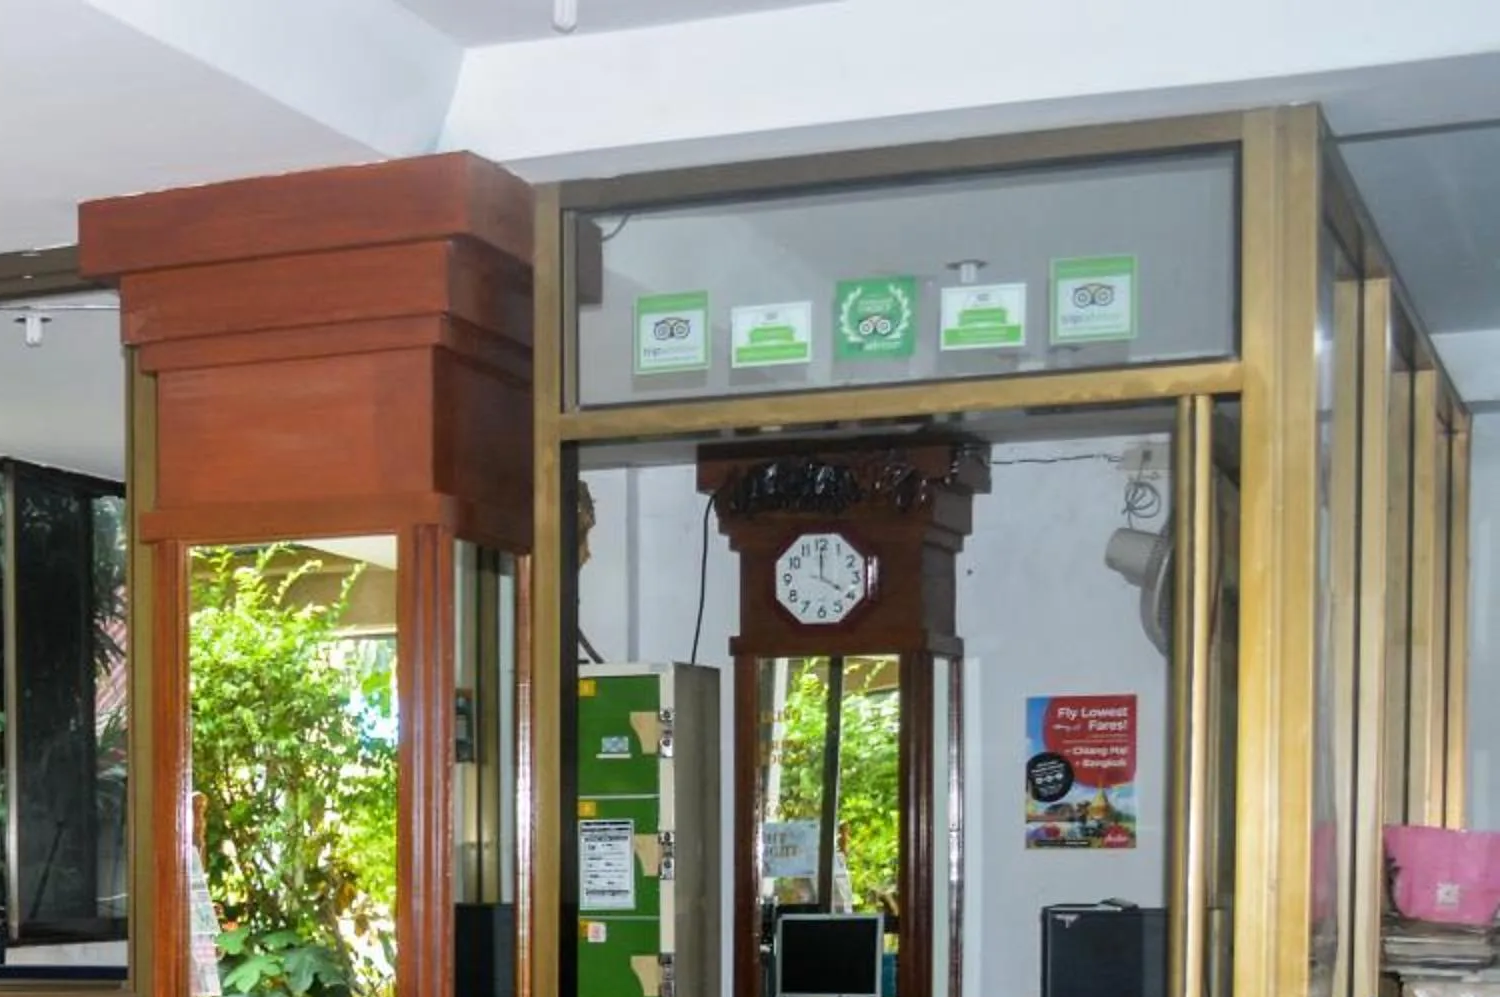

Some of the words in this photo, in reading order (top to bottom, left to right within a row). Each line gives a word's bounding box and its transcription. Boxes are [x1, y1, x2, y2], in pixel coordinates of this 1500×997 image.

[801, 543, 811, 557] 11
[815, 538, 828, 552] 12
[836, 543, 841, 556] 1
[789, 556, 801, 570] 10
[845, 554, 855, 569] 2
[782, 572, 792, 586] 9
[851, 570, 861, 585] 3
[788, 589, 798, 603] 8
[801, 600, 811, 613] 7
[817, 605, 827, 619] 6
[833, 600, 843, 614] 5
[1057, 706, 1078, 721] Fly
[1081, 706, 1128, 718] Lowest
